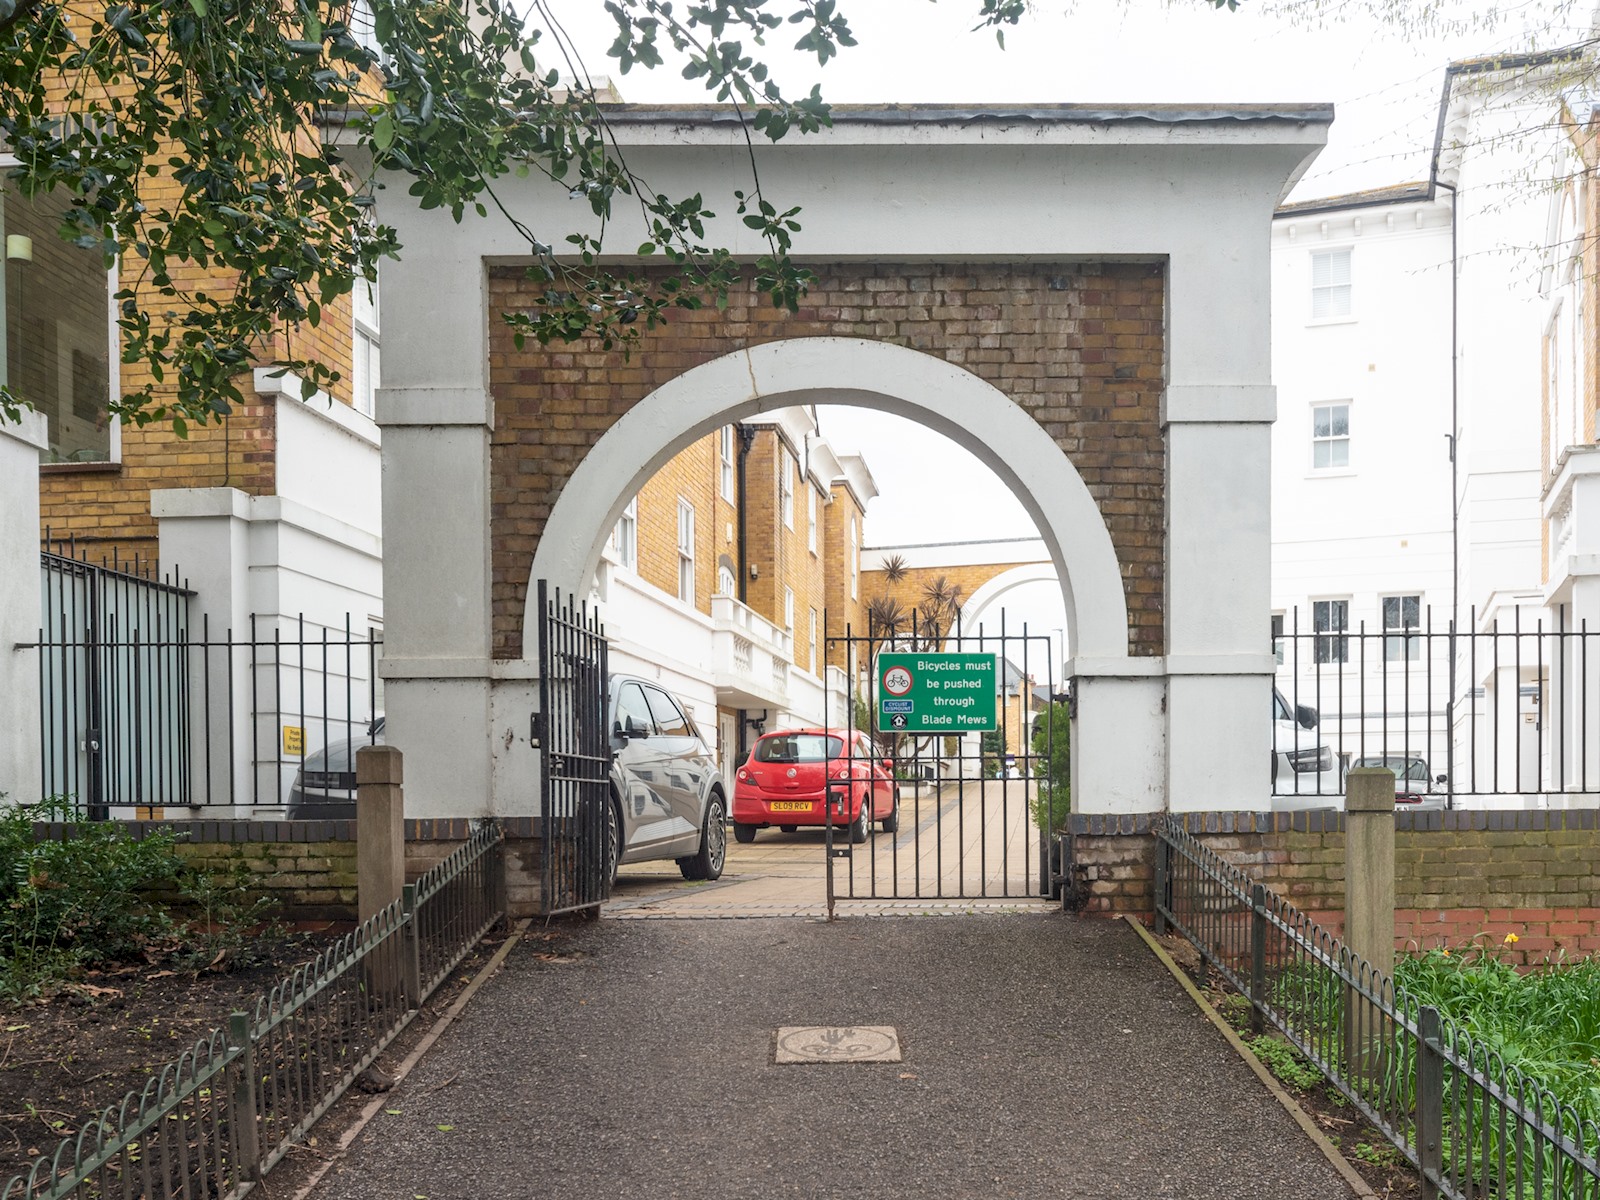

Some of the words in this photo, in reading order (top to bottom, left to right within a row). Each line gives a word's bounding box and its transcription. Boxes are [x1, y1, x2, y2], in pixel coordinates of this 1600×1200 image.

[917, 661, 961, 672] Bicycles
[965, 661, 992, 671] must
[926, 679, 940, 688] be
[944, 679, 982, 690] pushed
[933, 697, 975, 707] through
[922, 715, 952, 724] Blade
[957, 715, 987, 724] Mews
[773, 802, 793, 810] SL09
[794, 802, 809, 810] RCV
